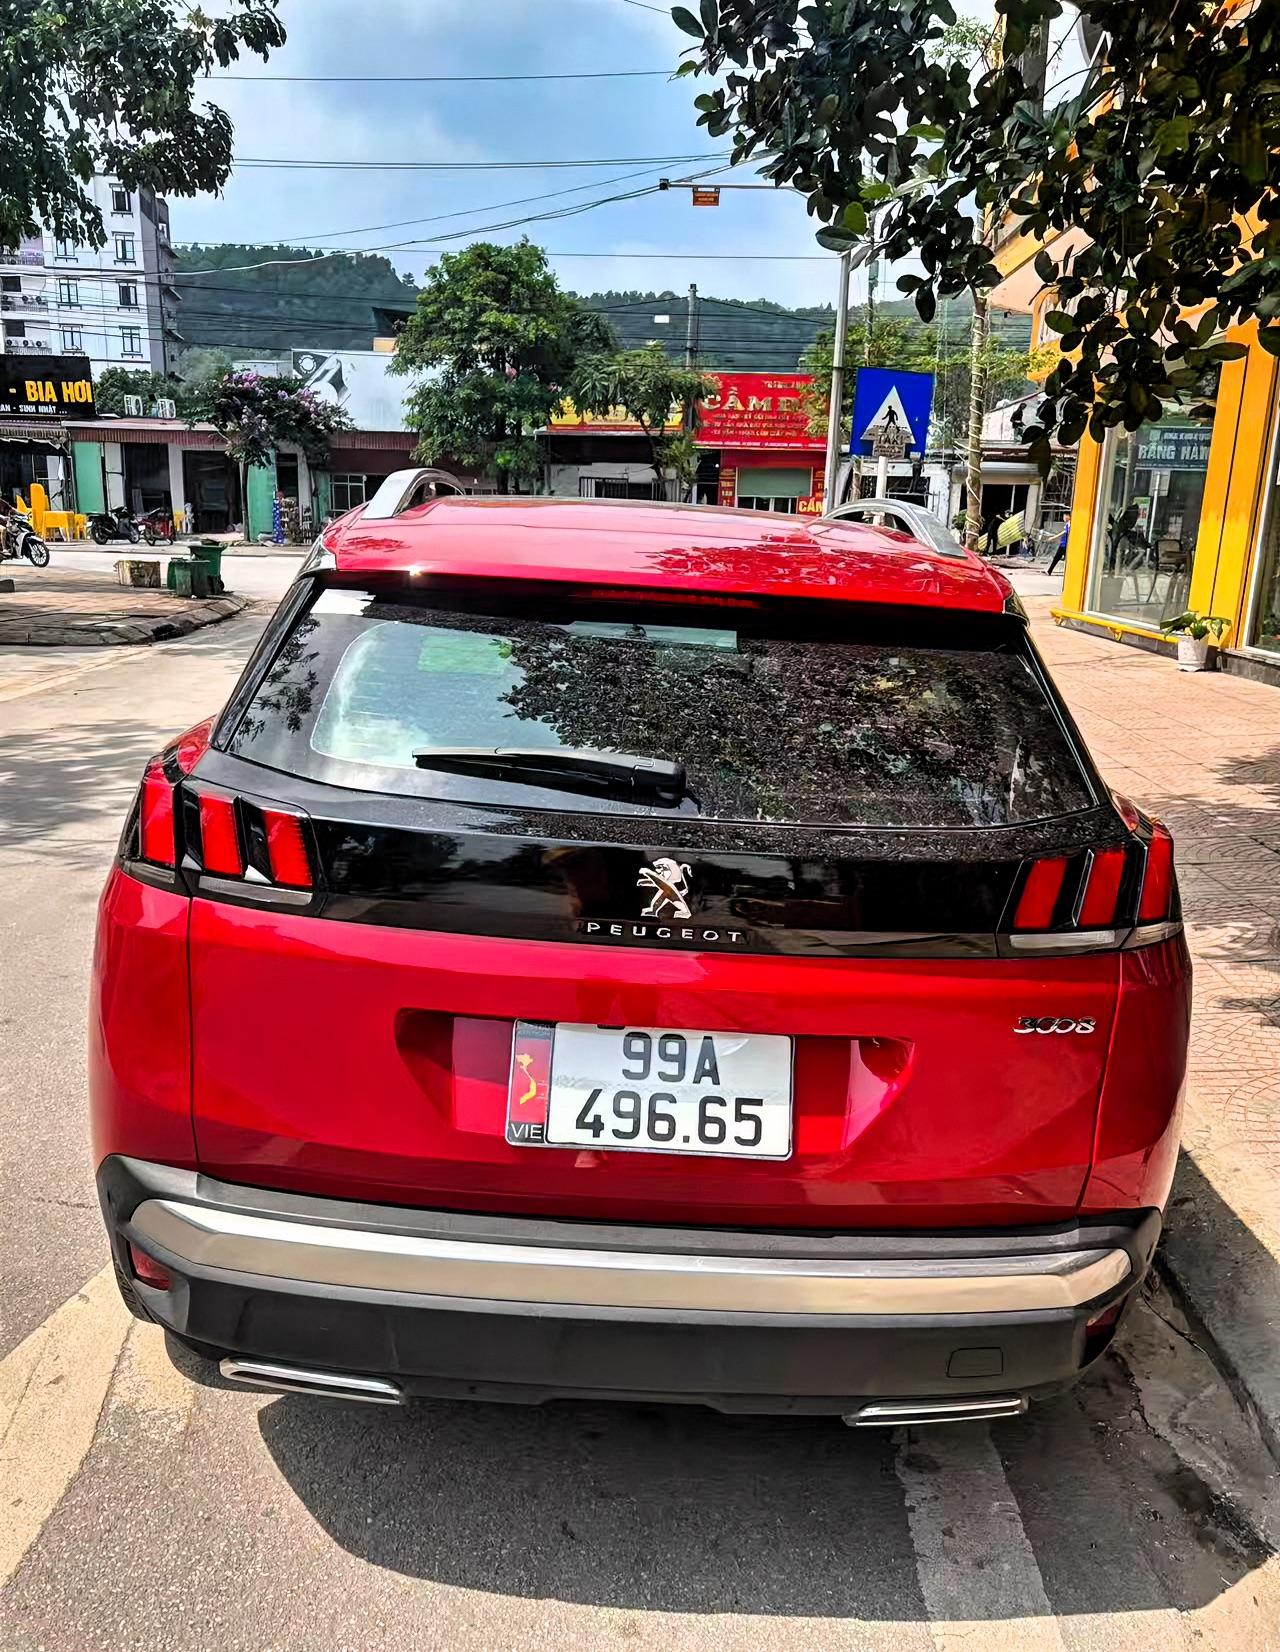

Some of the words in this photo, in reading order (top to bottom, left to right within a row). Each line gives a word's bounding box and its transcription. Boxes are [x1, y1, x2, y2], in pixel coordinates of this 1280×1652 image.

[25, 381, 58, 402] BIA
[61, 380, 93, 403] HƠI
[586, 922, 742, 942] PEUGEOT
[1012, 1016, 1096, 1034] 3008
[622, 1031, 720, 1085] 99A
[575, 1088, 763, 1147] 496.65
[511, 1123, 542, 1140] VIE
